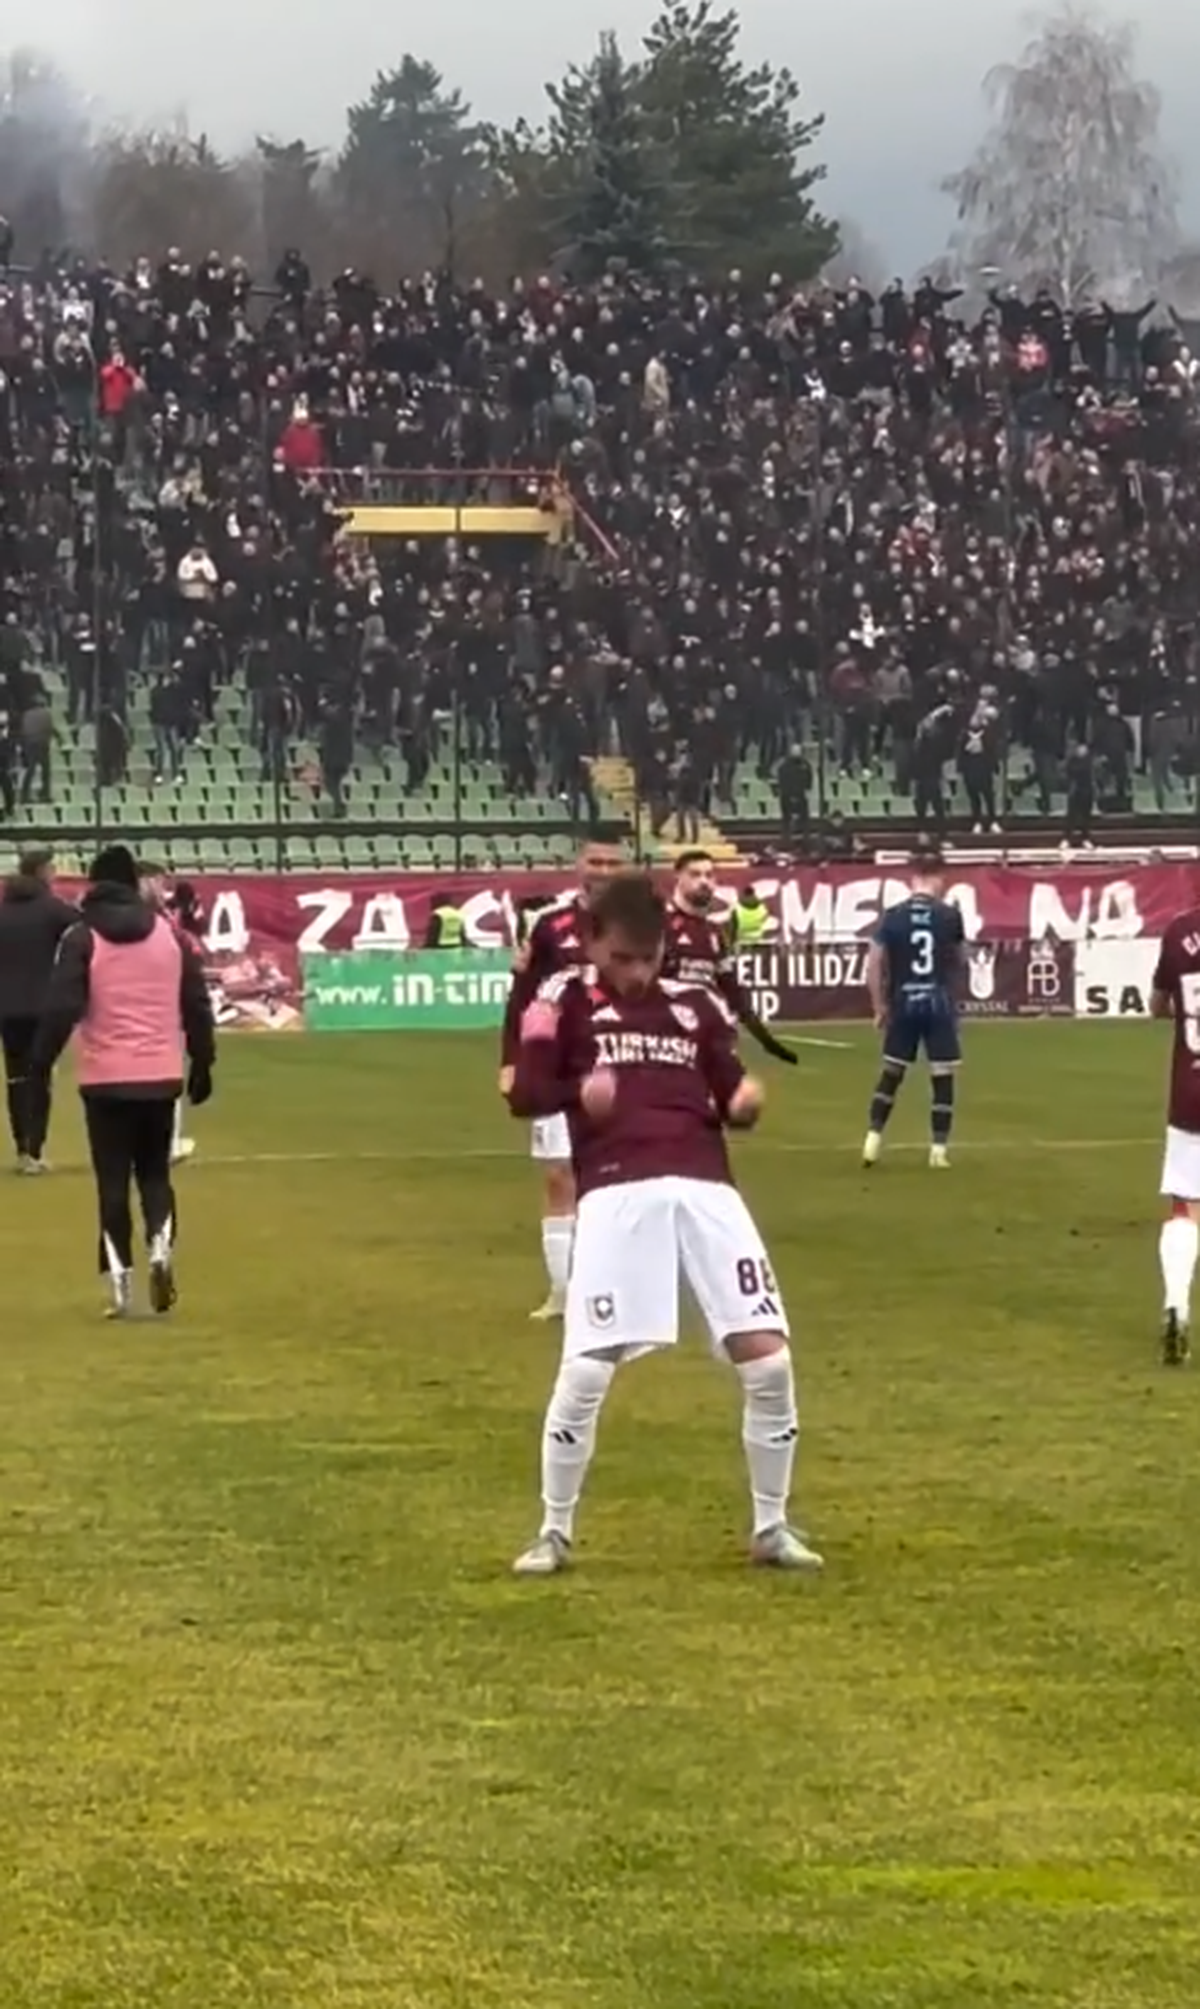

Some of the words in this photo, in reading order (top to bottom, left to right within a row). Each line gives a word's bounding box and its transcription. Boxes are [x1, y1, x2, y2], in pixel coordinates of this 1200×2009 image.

[297, 888, 410, 952] ZA
[1030, 881, 1144, 942] NA
[737, 953, 779, 987] ELI
[911, 930, 934, 974] 3
[1086, 985, 1145, 1014] SA
